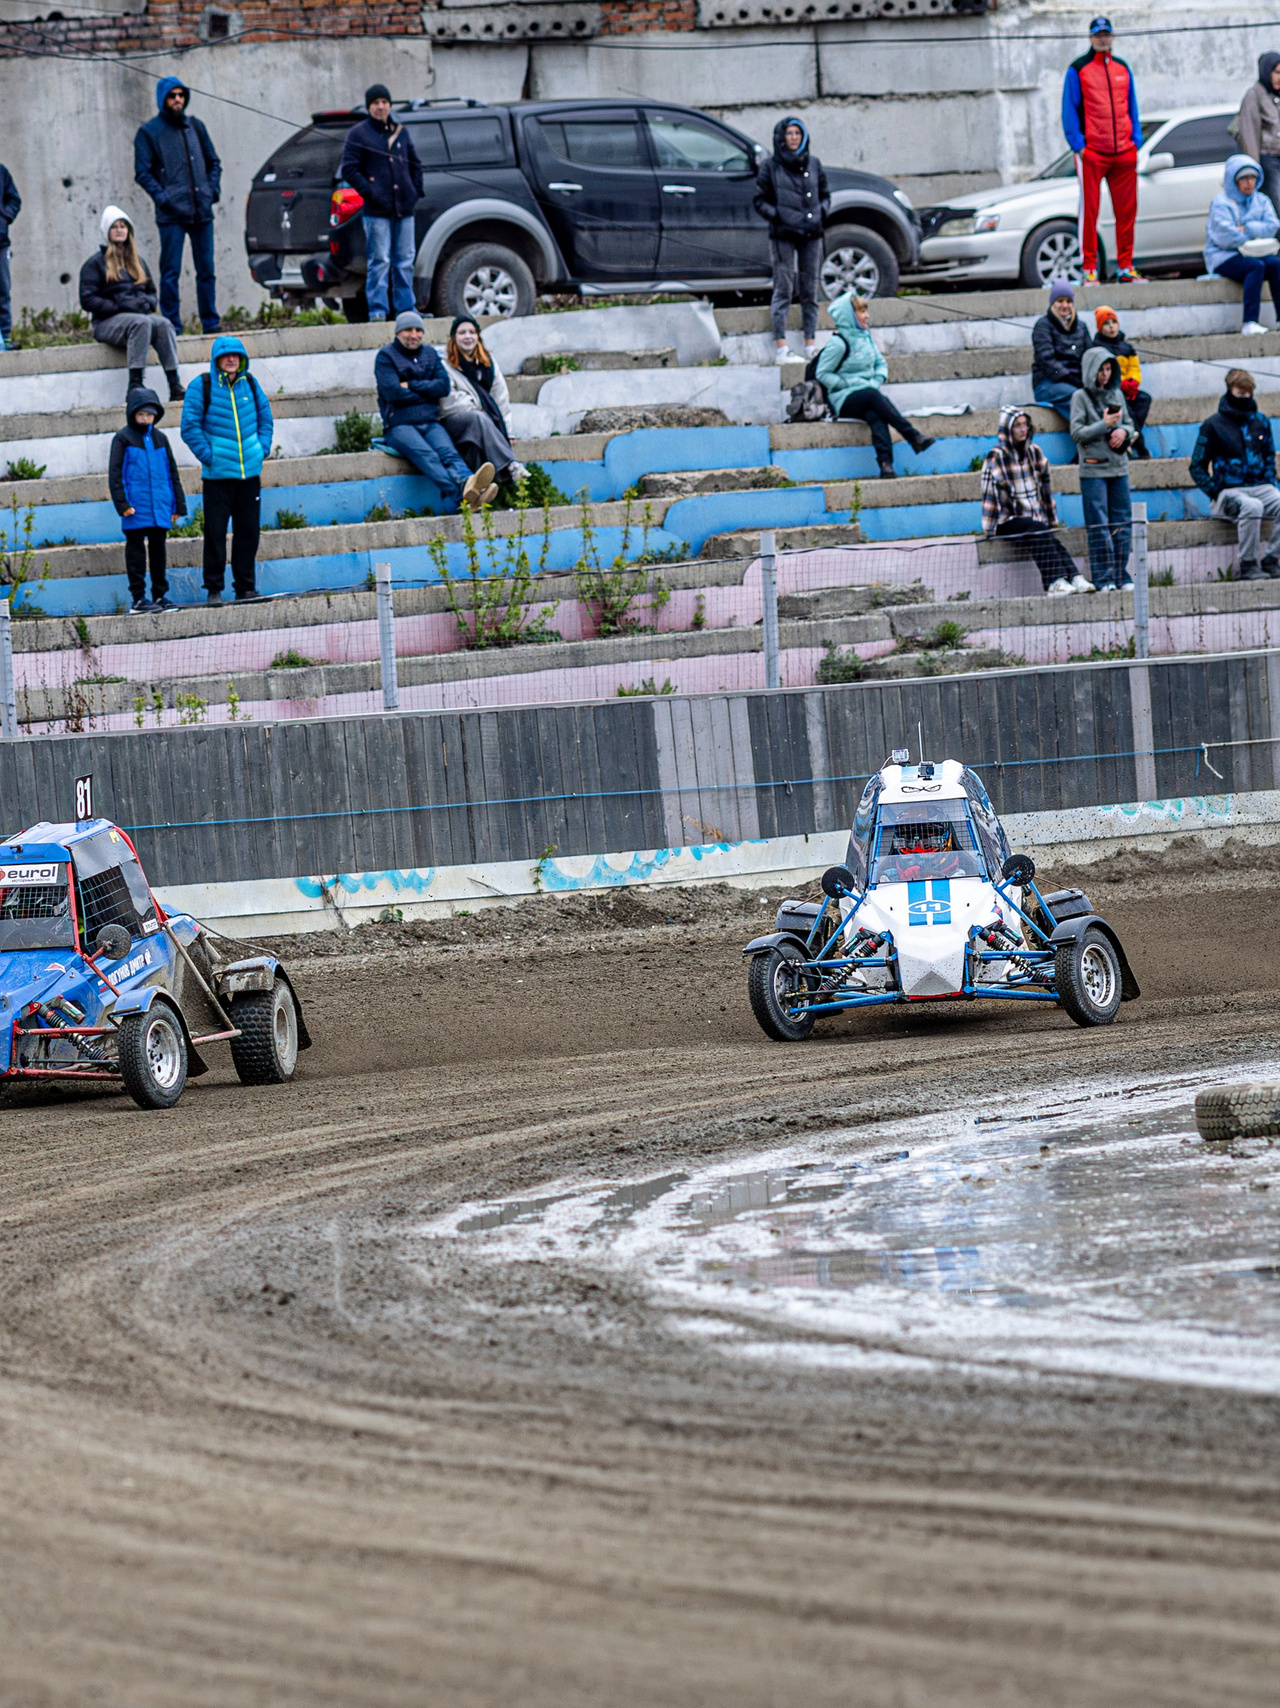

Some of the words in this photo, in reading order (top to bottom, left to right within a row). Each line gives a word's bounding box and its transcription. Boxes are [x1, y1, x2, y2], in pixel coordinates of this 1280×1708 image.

[76, 778, 92, 819] 81
[8, 866, 55, 878] eurol
[915, 903, 941, 911] 11
